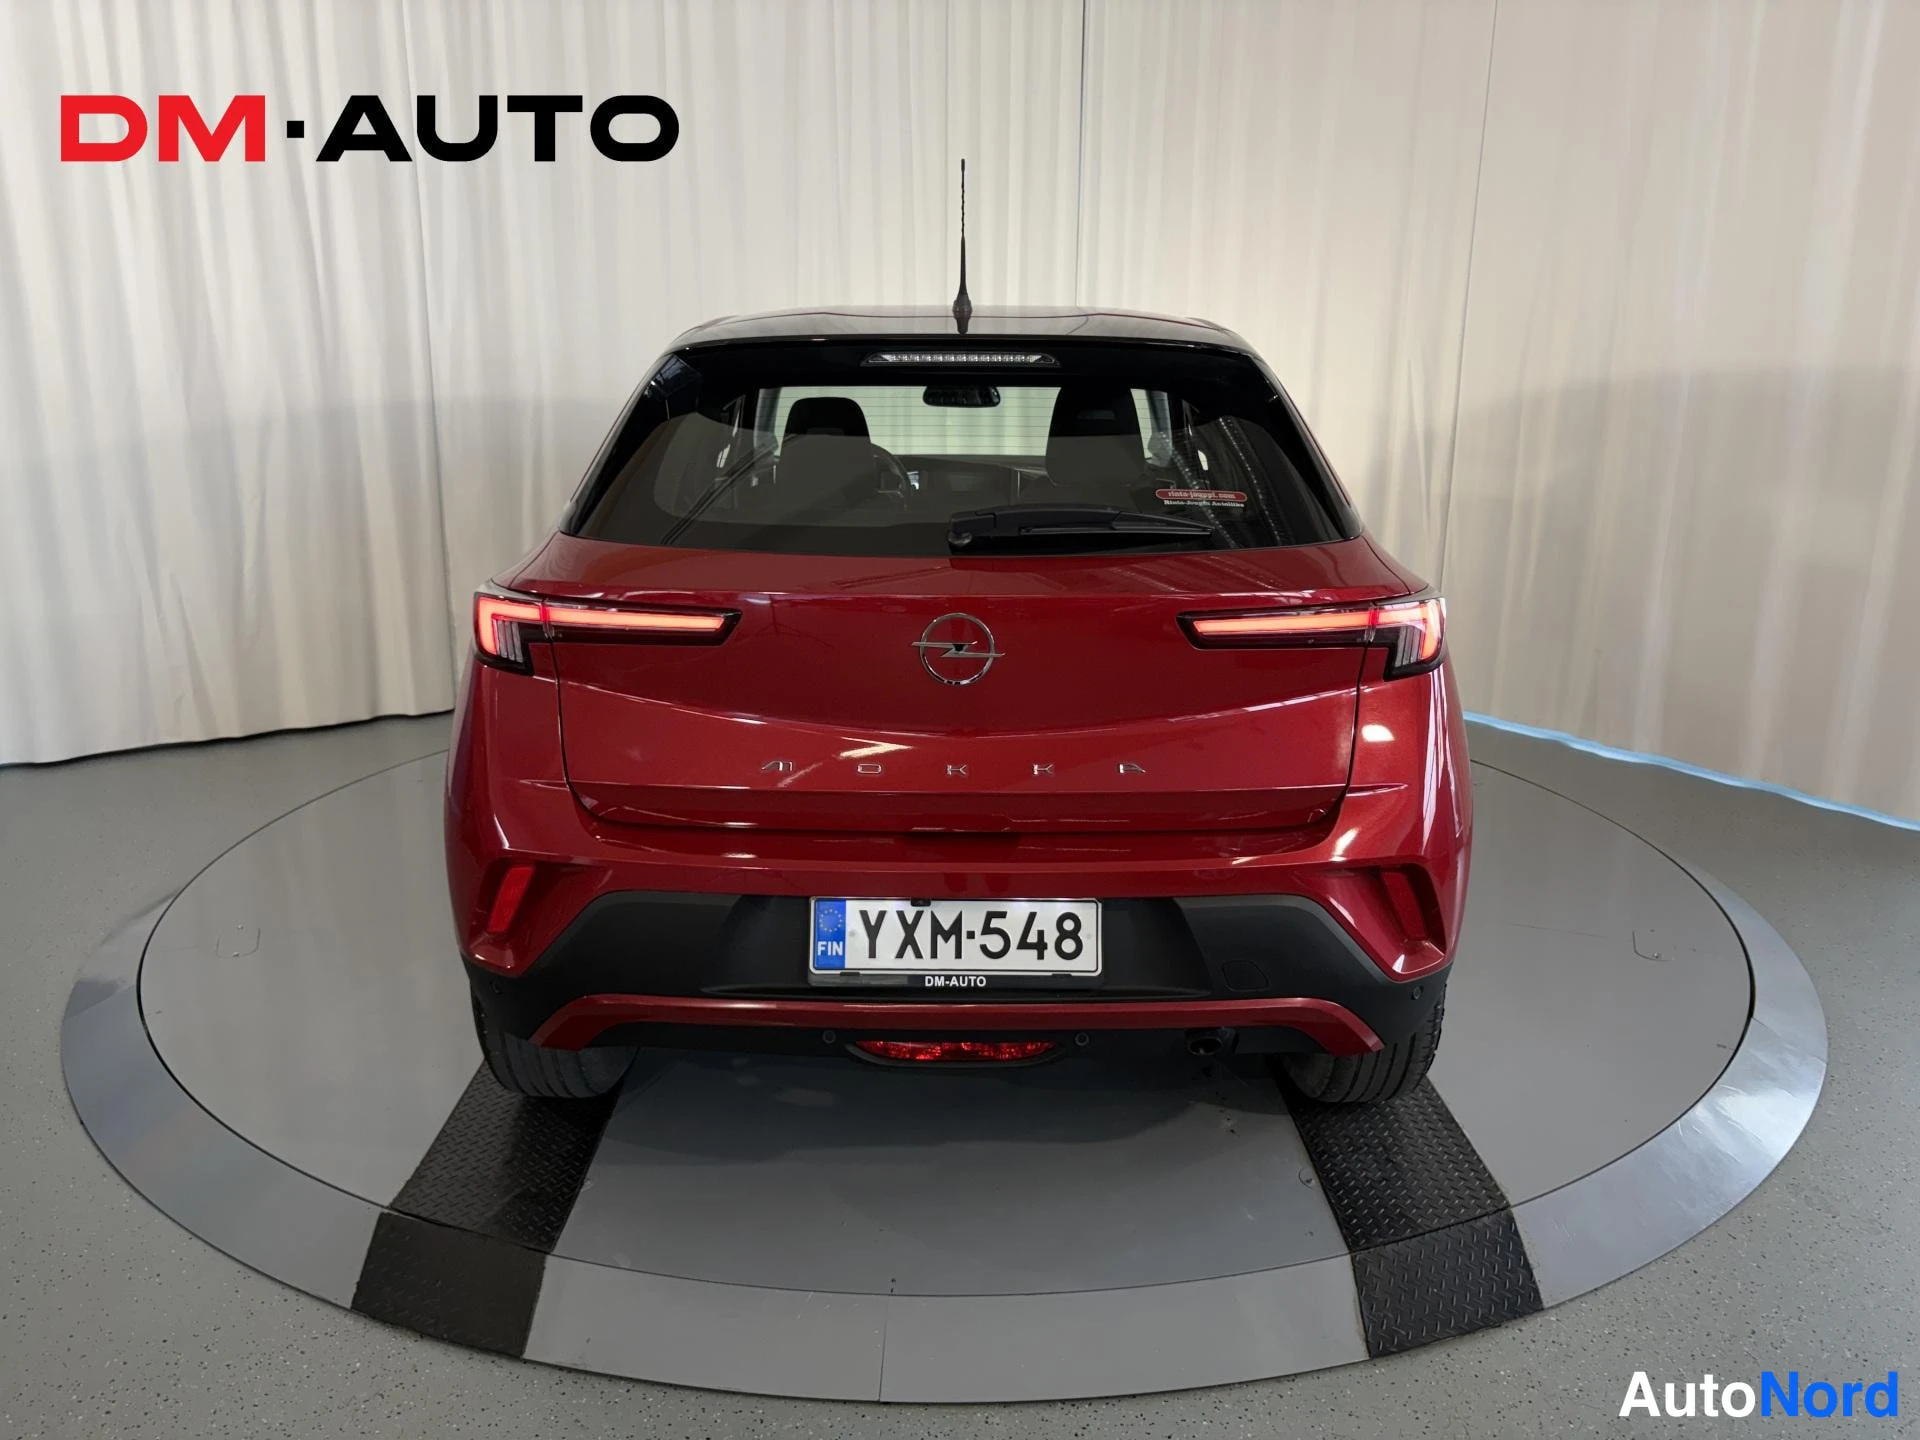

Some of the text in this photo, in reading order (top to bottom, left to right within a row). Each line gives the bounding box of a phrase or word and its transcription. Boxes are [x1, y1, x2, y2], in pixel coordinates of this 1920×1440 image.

[761, 761, 1146, 776] MOKKA
[859, 910, 1084, 961] YXM-548
[817, 941, 844, 957] FIN
[924, 975, 987, 988] DM-AUTO
